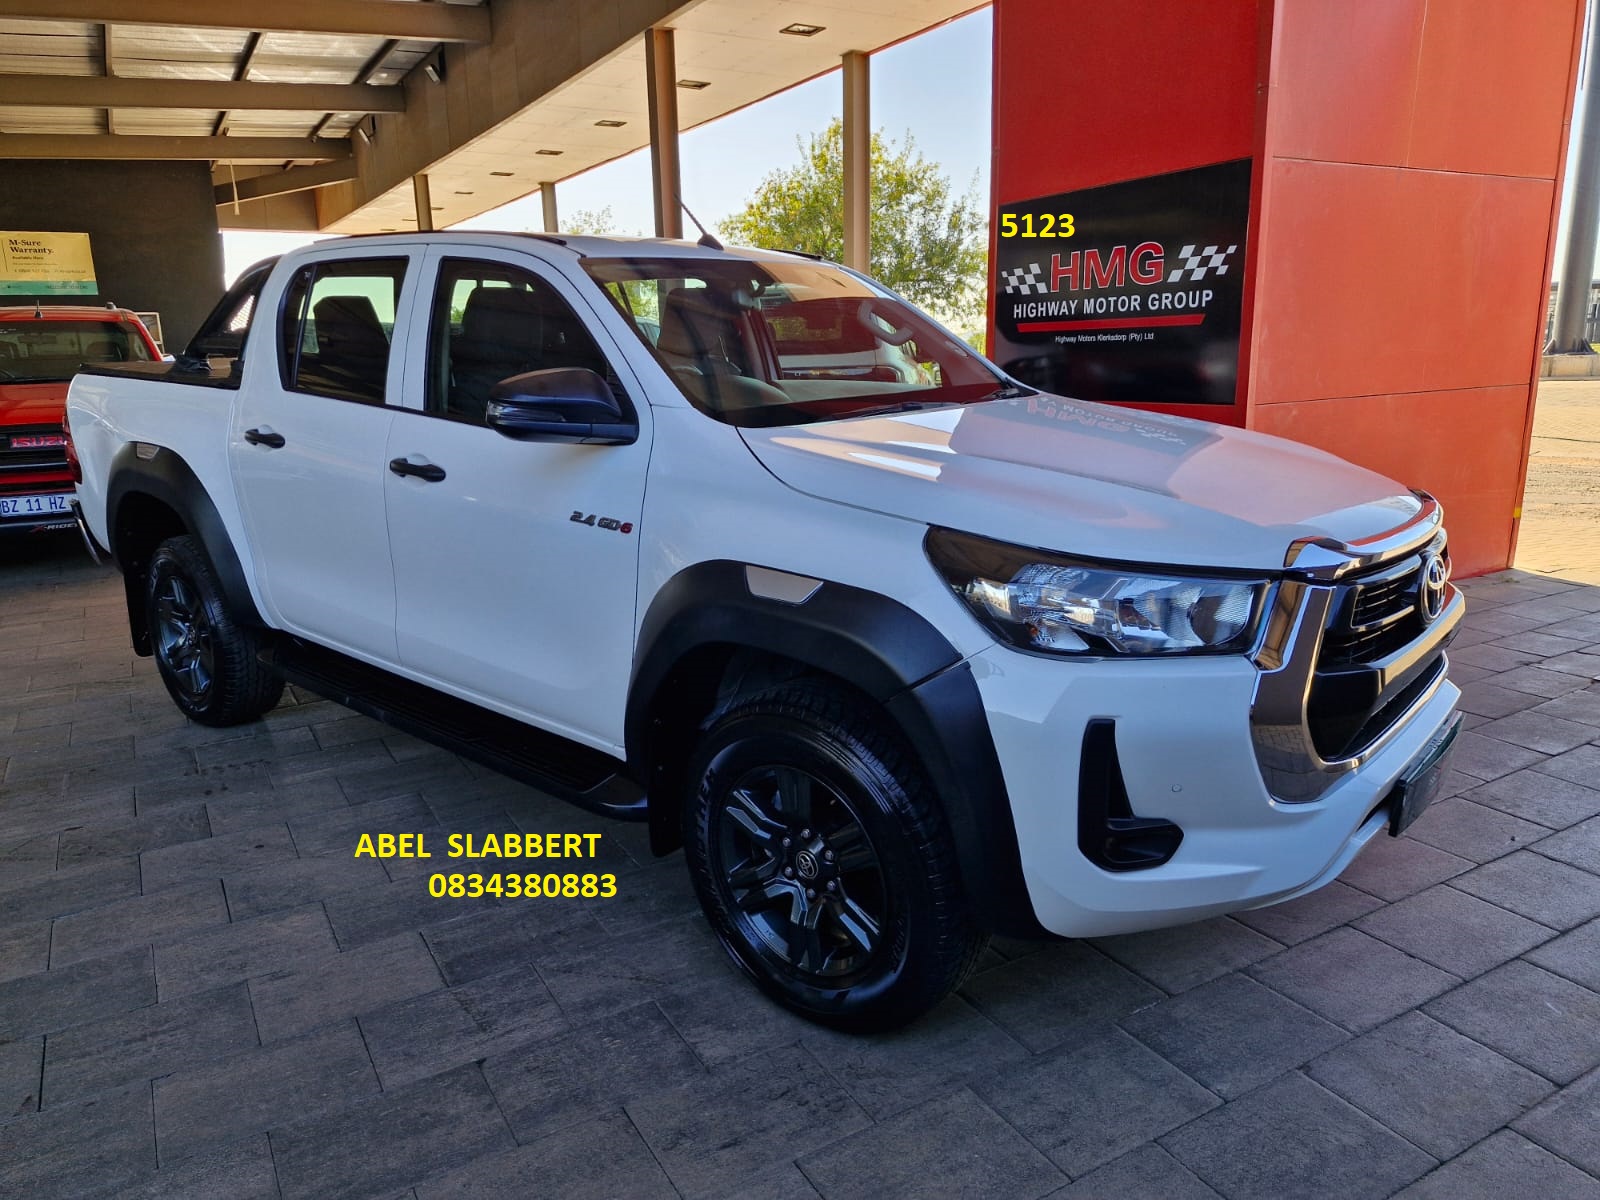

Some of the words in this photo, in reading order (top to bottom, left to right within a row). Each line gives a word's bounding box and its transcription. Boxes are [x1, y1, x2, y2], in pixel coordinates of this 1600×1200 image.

[9, 239, 41, 247] M-Sure
[1050, 241, 1165, 293] HMG
[1013, 299, 1078, 319] HIGHWAY
[1083, 295, 1141, 315] MOTOR
[1148, 290, 1213, 311] GROUP
[1055, 335, 1077, 344] Highway
[1077, 334, 1097, 342] Motors
[1128, 332, 1143, 342] (Pty)
[1144, 332, 1155, 340] Ltd
[26, 498, 42, 512] 11
[49, 496, 66, 510] HZ
